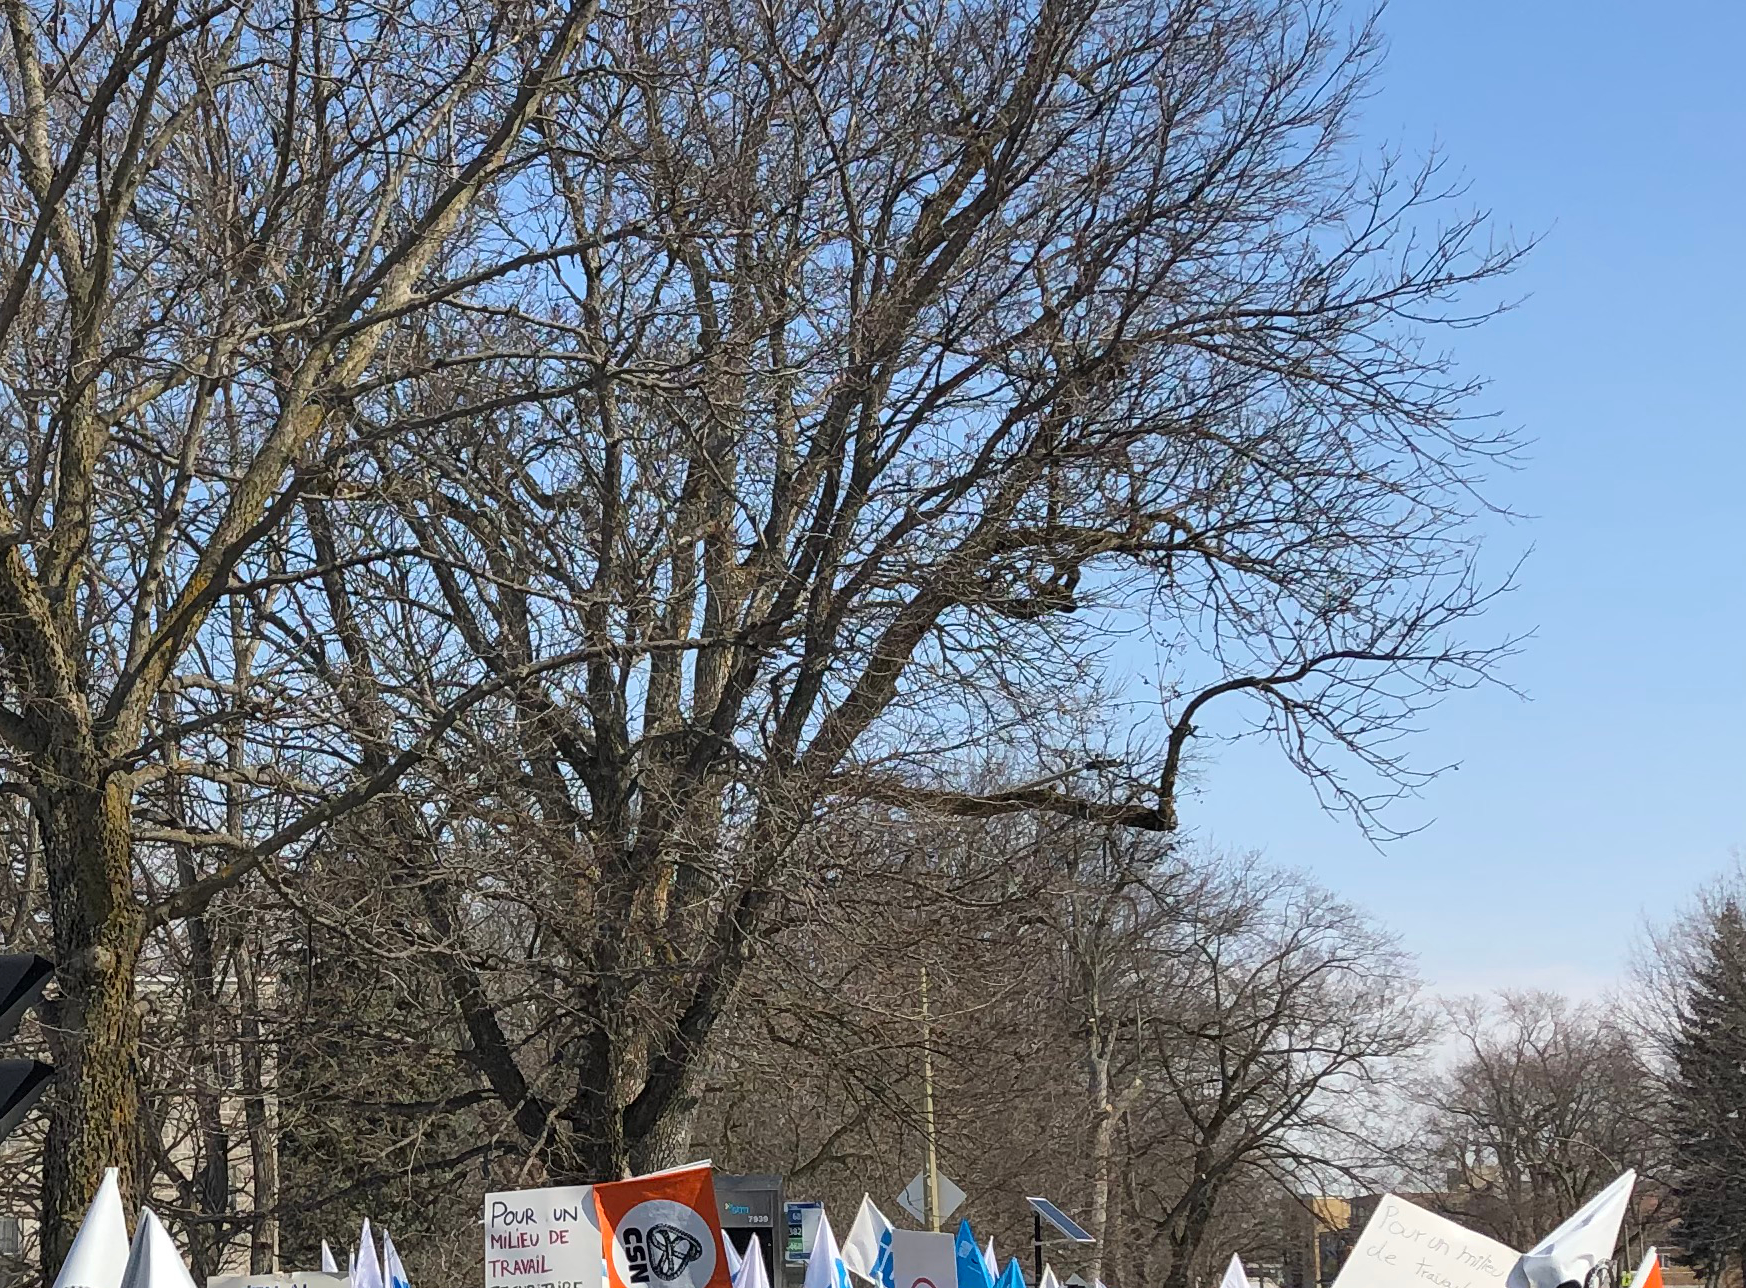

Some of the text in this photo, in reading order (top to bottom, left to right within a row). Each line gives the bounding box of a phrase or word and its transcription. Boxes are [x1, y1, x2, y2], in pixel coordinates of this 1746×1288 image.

[553, 1205, 578, 1222] UN
[549, 1229, 570, 1245] DE
[1379, 1205, 1426, 1241] Pour
[1428, 1236, 1450, 1255] un
[622, 1227, 650, 1284] CSN
[1367, 1241, 1396, 1266] de
